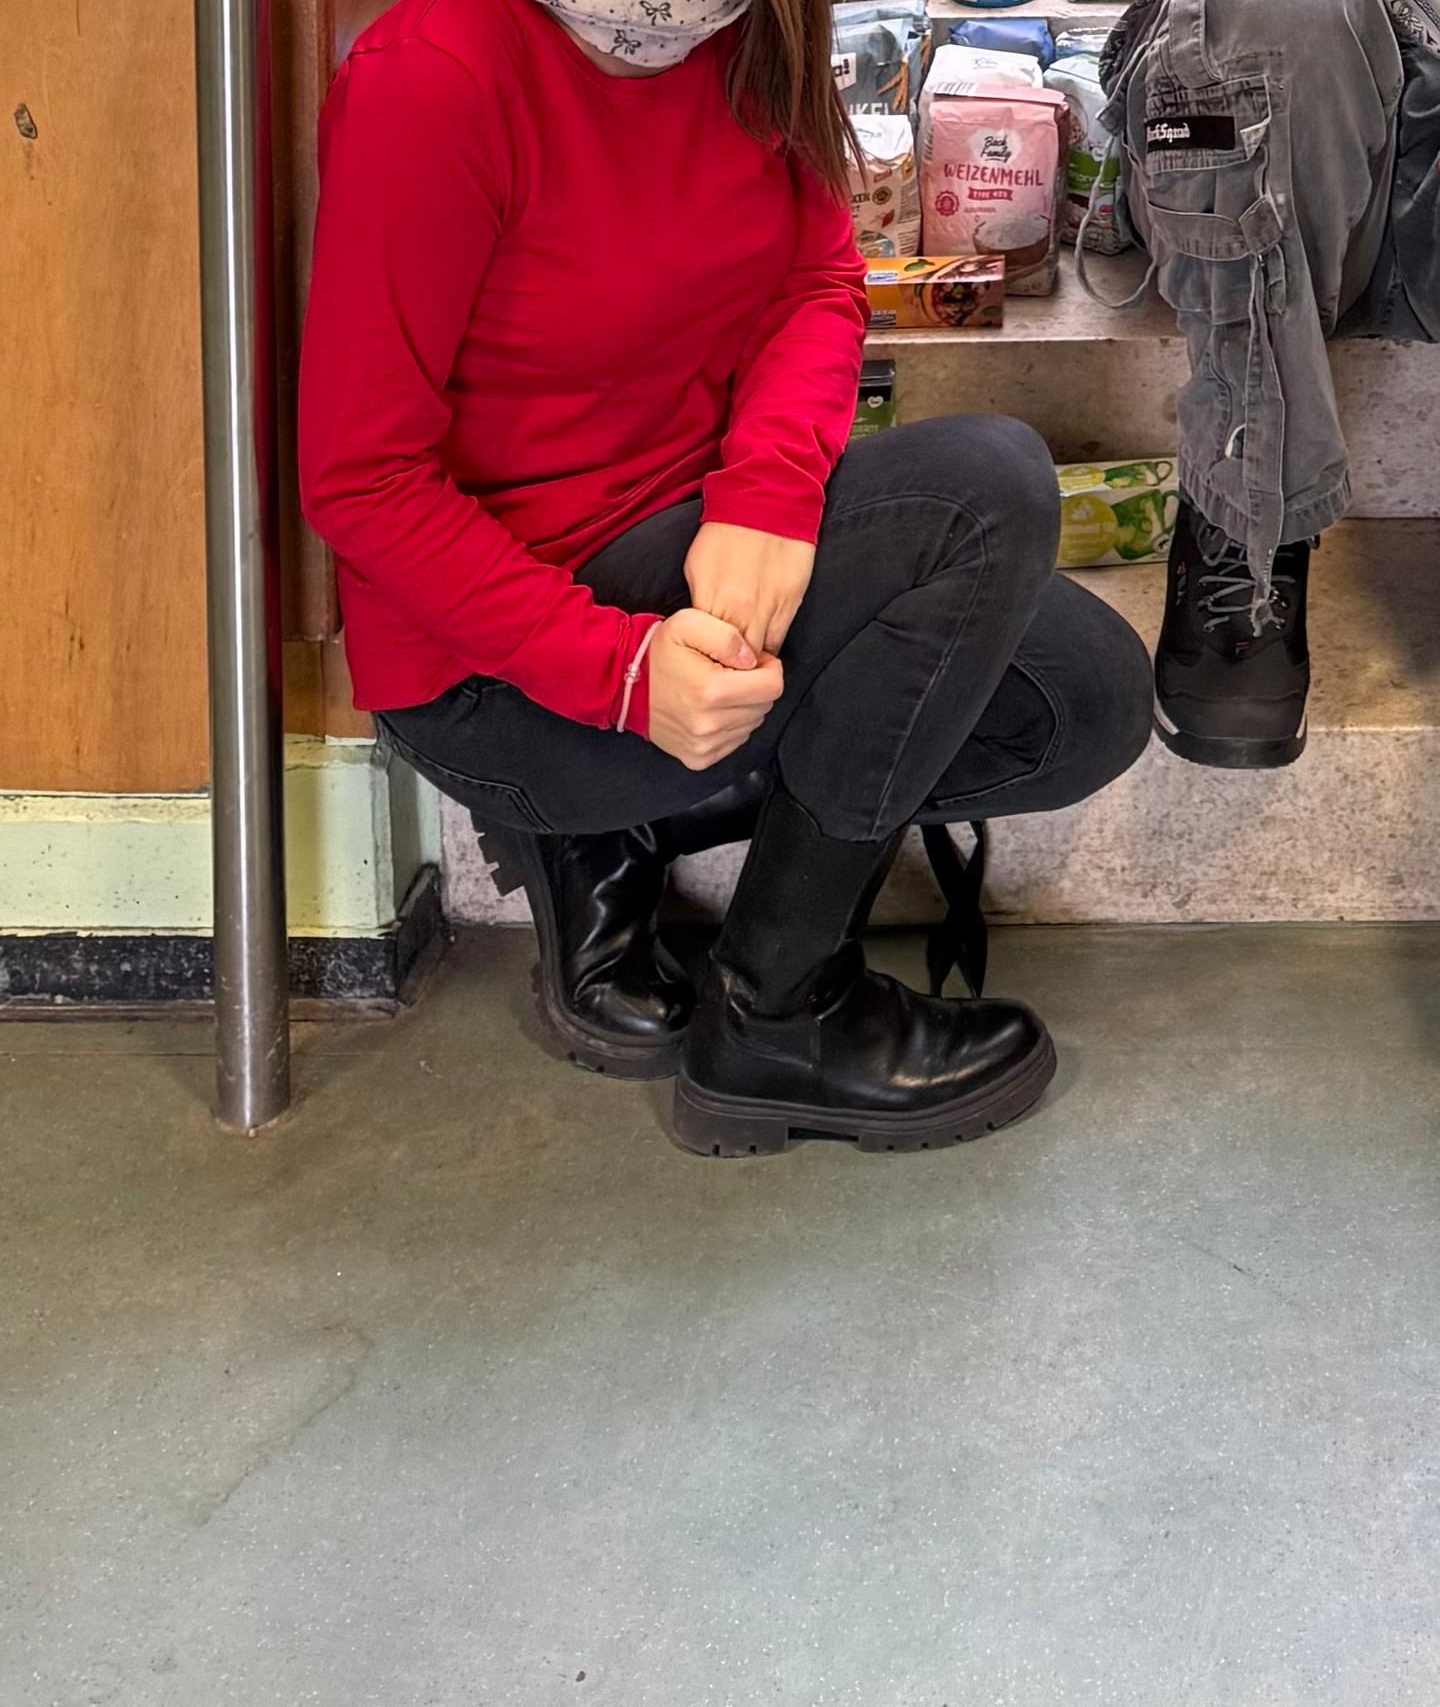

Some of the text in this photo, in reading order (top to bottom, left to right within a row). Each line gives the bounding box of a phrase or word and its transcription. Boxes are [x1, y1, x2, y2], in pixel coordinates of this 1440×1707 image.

[984, 135, 1007, 149] Back
[980, 147, 1012, 163] Family
[943, 163, 1044, 188] WEIZENMEHL
